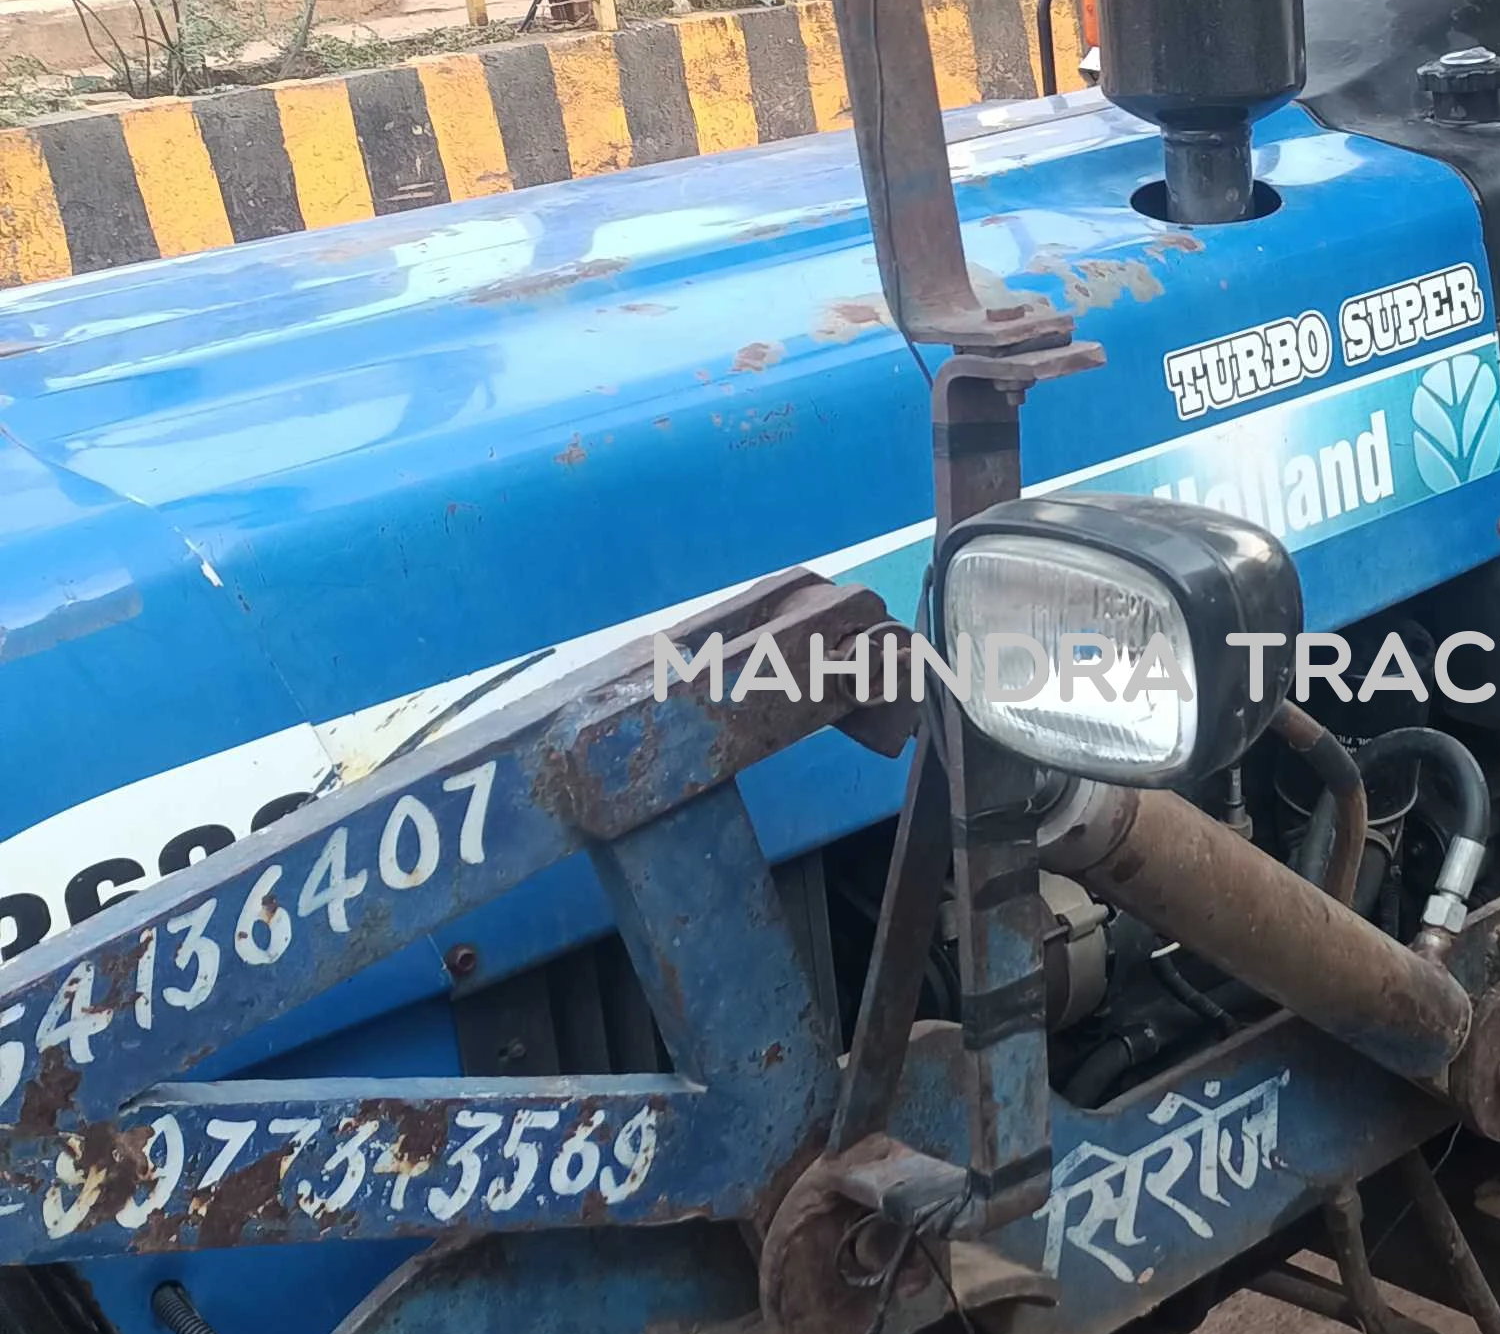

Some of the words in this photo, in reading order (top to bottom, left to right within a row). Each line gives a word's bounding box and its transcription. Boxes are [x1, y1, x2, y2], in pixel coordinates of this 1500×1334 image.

[1164, 310, 1330, 419] TURBO
[1340, 262, 1485, 365] SUPER
[1032, 1069, 1290, 1284] सिरोंज
